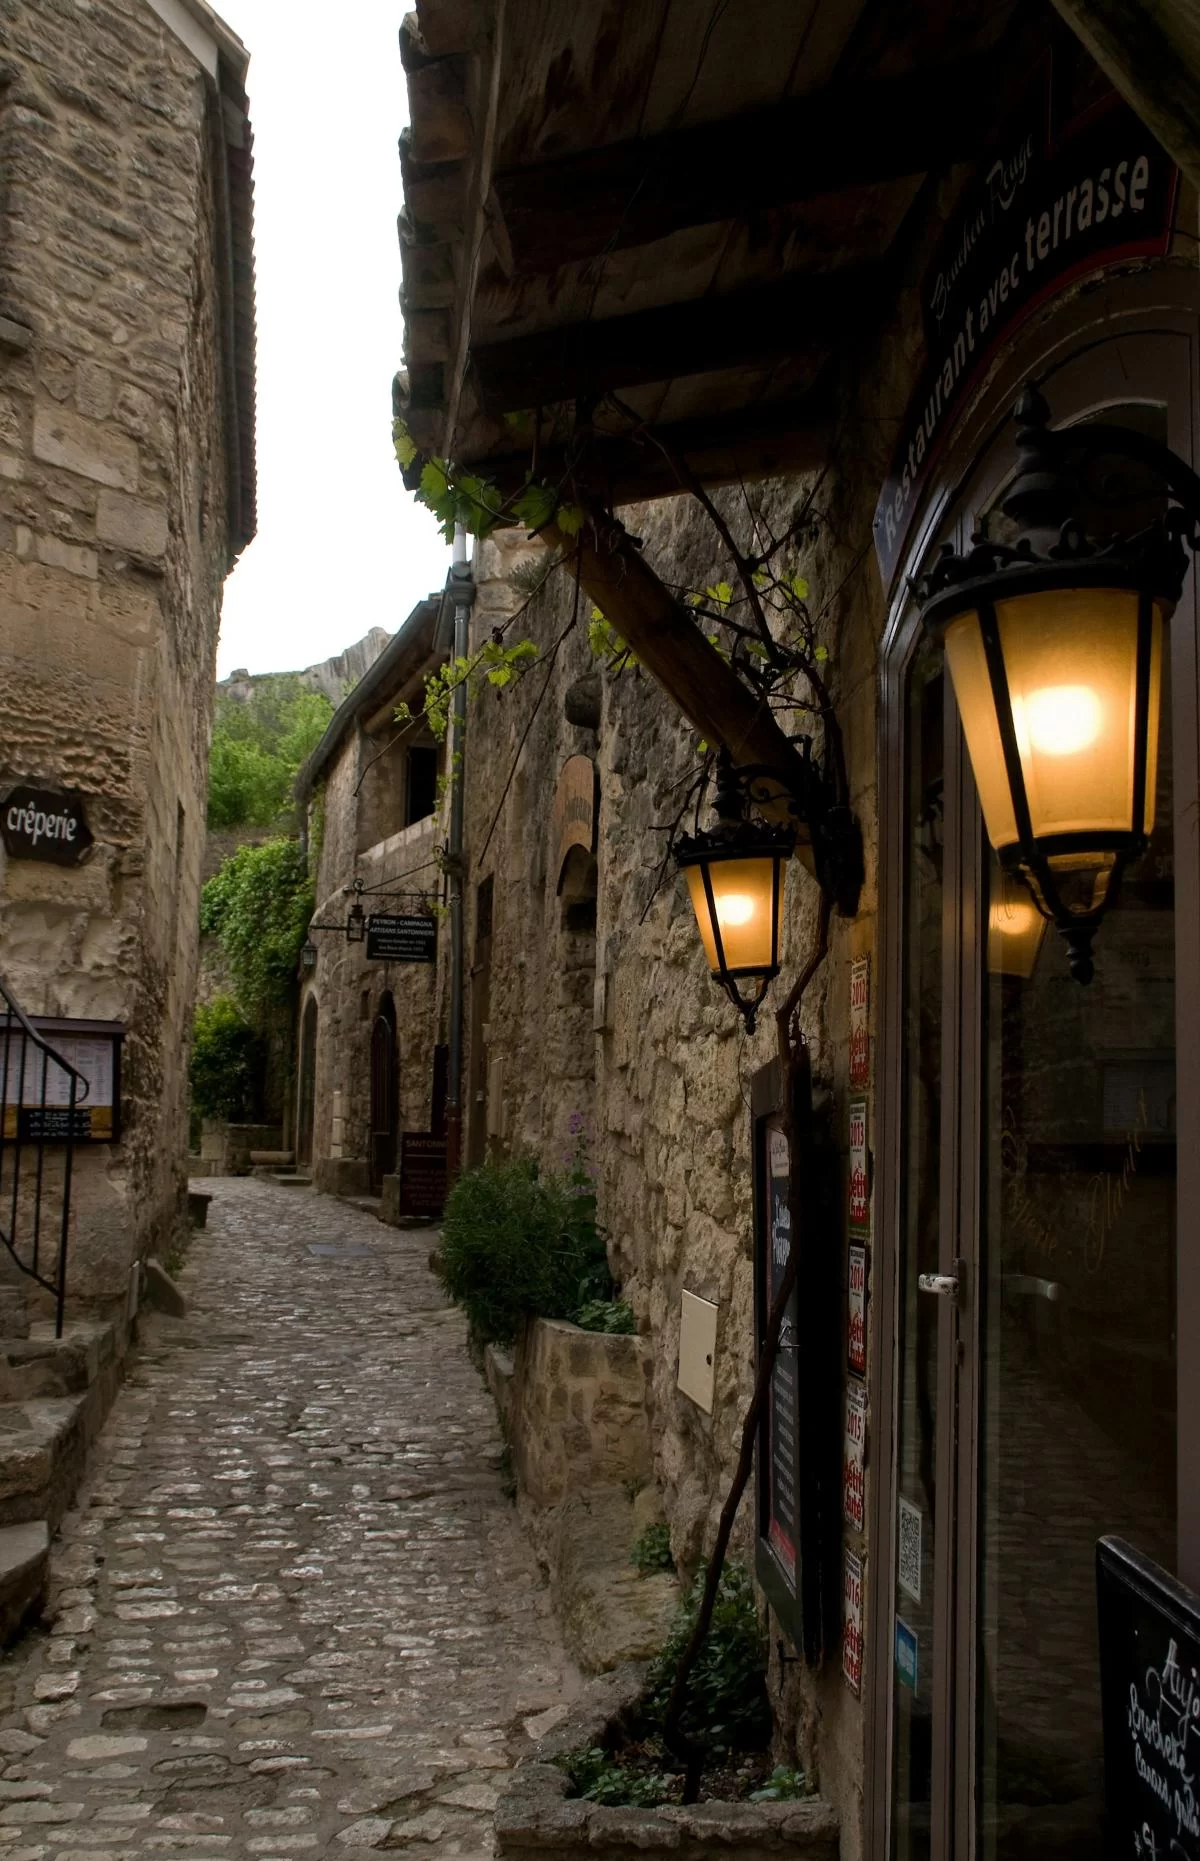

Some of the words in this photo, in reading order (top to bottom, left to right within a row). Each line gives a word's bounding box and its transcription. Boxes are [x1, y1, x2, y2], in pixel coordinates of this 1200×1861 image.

[883, 306, 976, 552] Restaurant
[979, 252, 1020, 334] avec
[1024, 154, 1149, 272] terrasse
[6, 800, 78, 847] crêperie
[851, 979, 866, 1007] 2012
[850, 1122, 864, 1147] 2013
[850, 1264, 864, 1291] 2014
[847, 1409, 862, 1441] 2015
[845, 1571, 861, 1608] 2016
